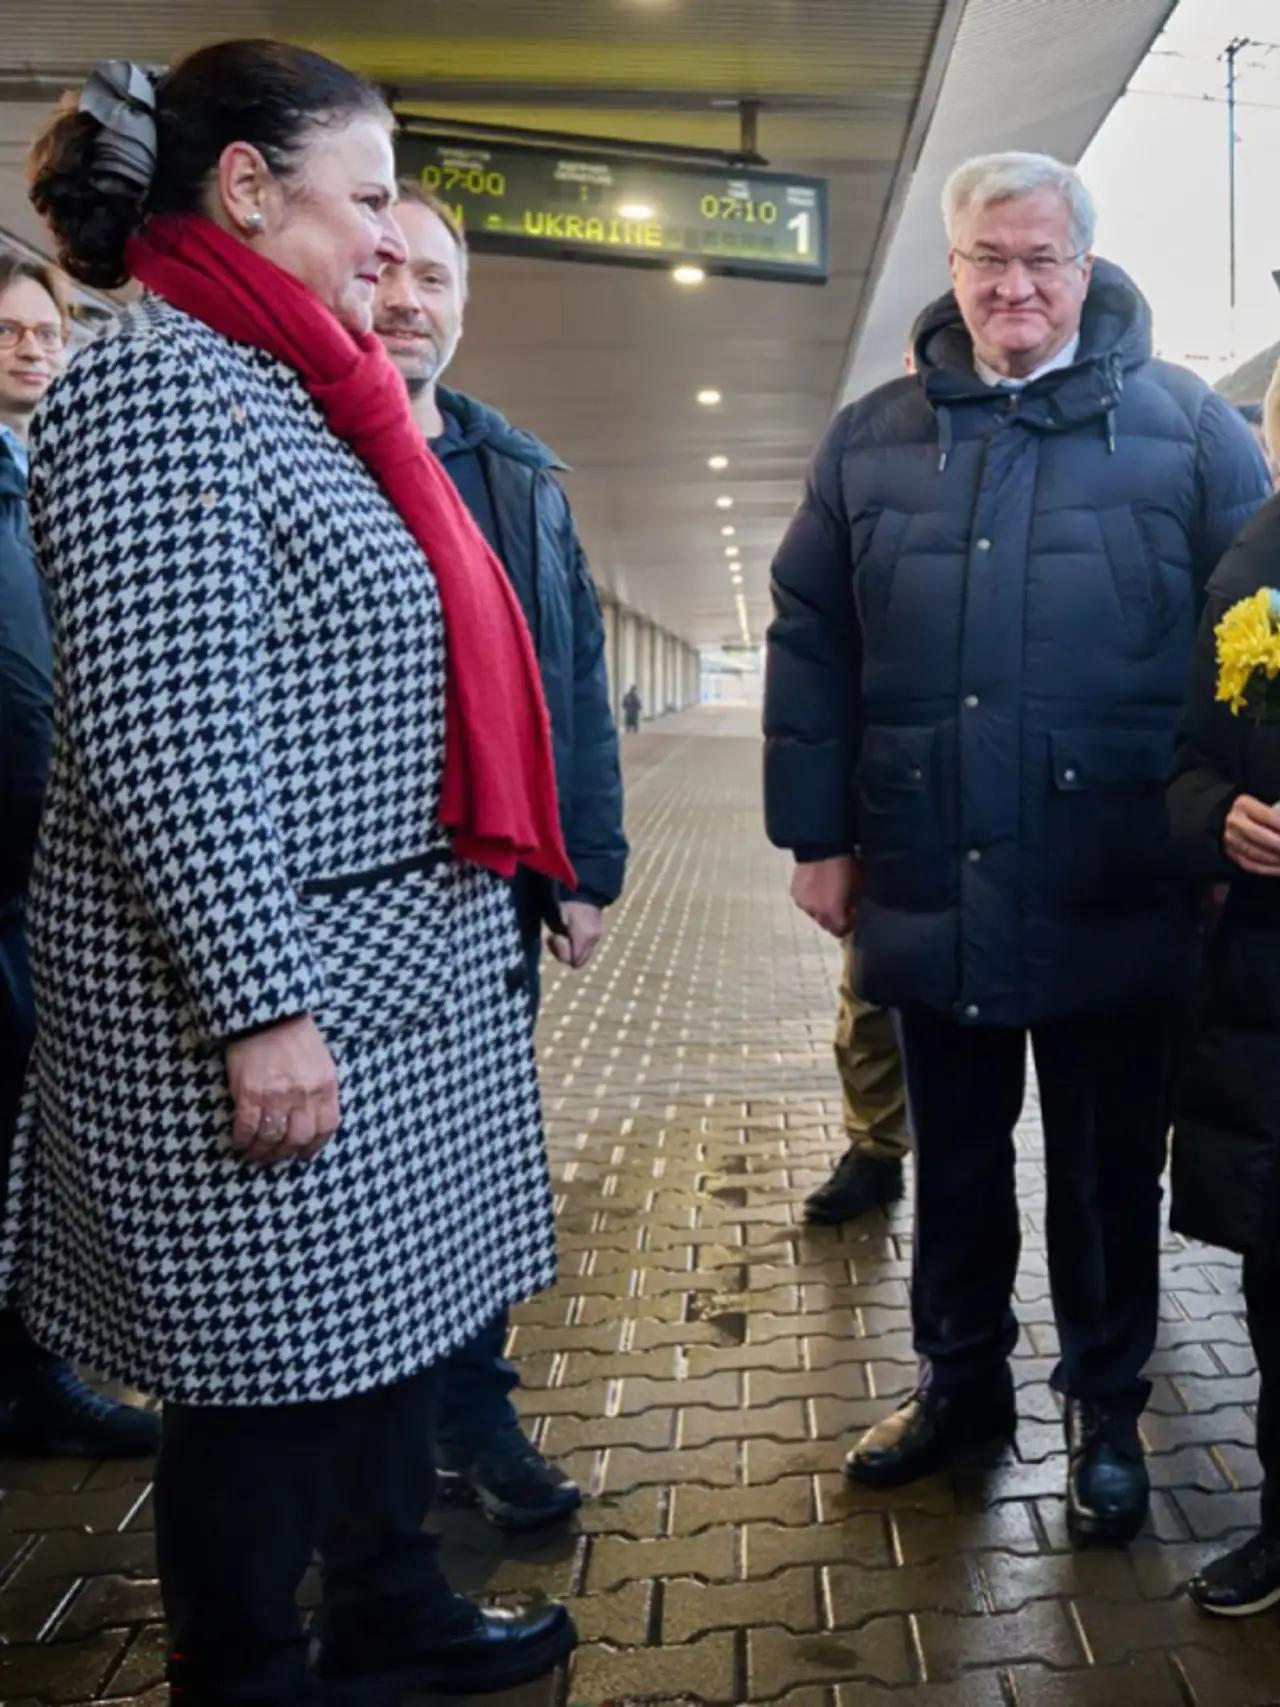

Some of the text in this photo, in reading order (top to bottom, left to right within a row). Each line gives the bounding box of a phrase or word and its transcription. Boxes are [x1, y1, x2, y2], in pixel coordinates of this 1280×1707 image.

[422, 165, 506, 197] 07:00
[701, 194, 778, 224] 07:10
[523, 209, 663, 247] UKRAINE
[787, 210, 809, 254] 1
